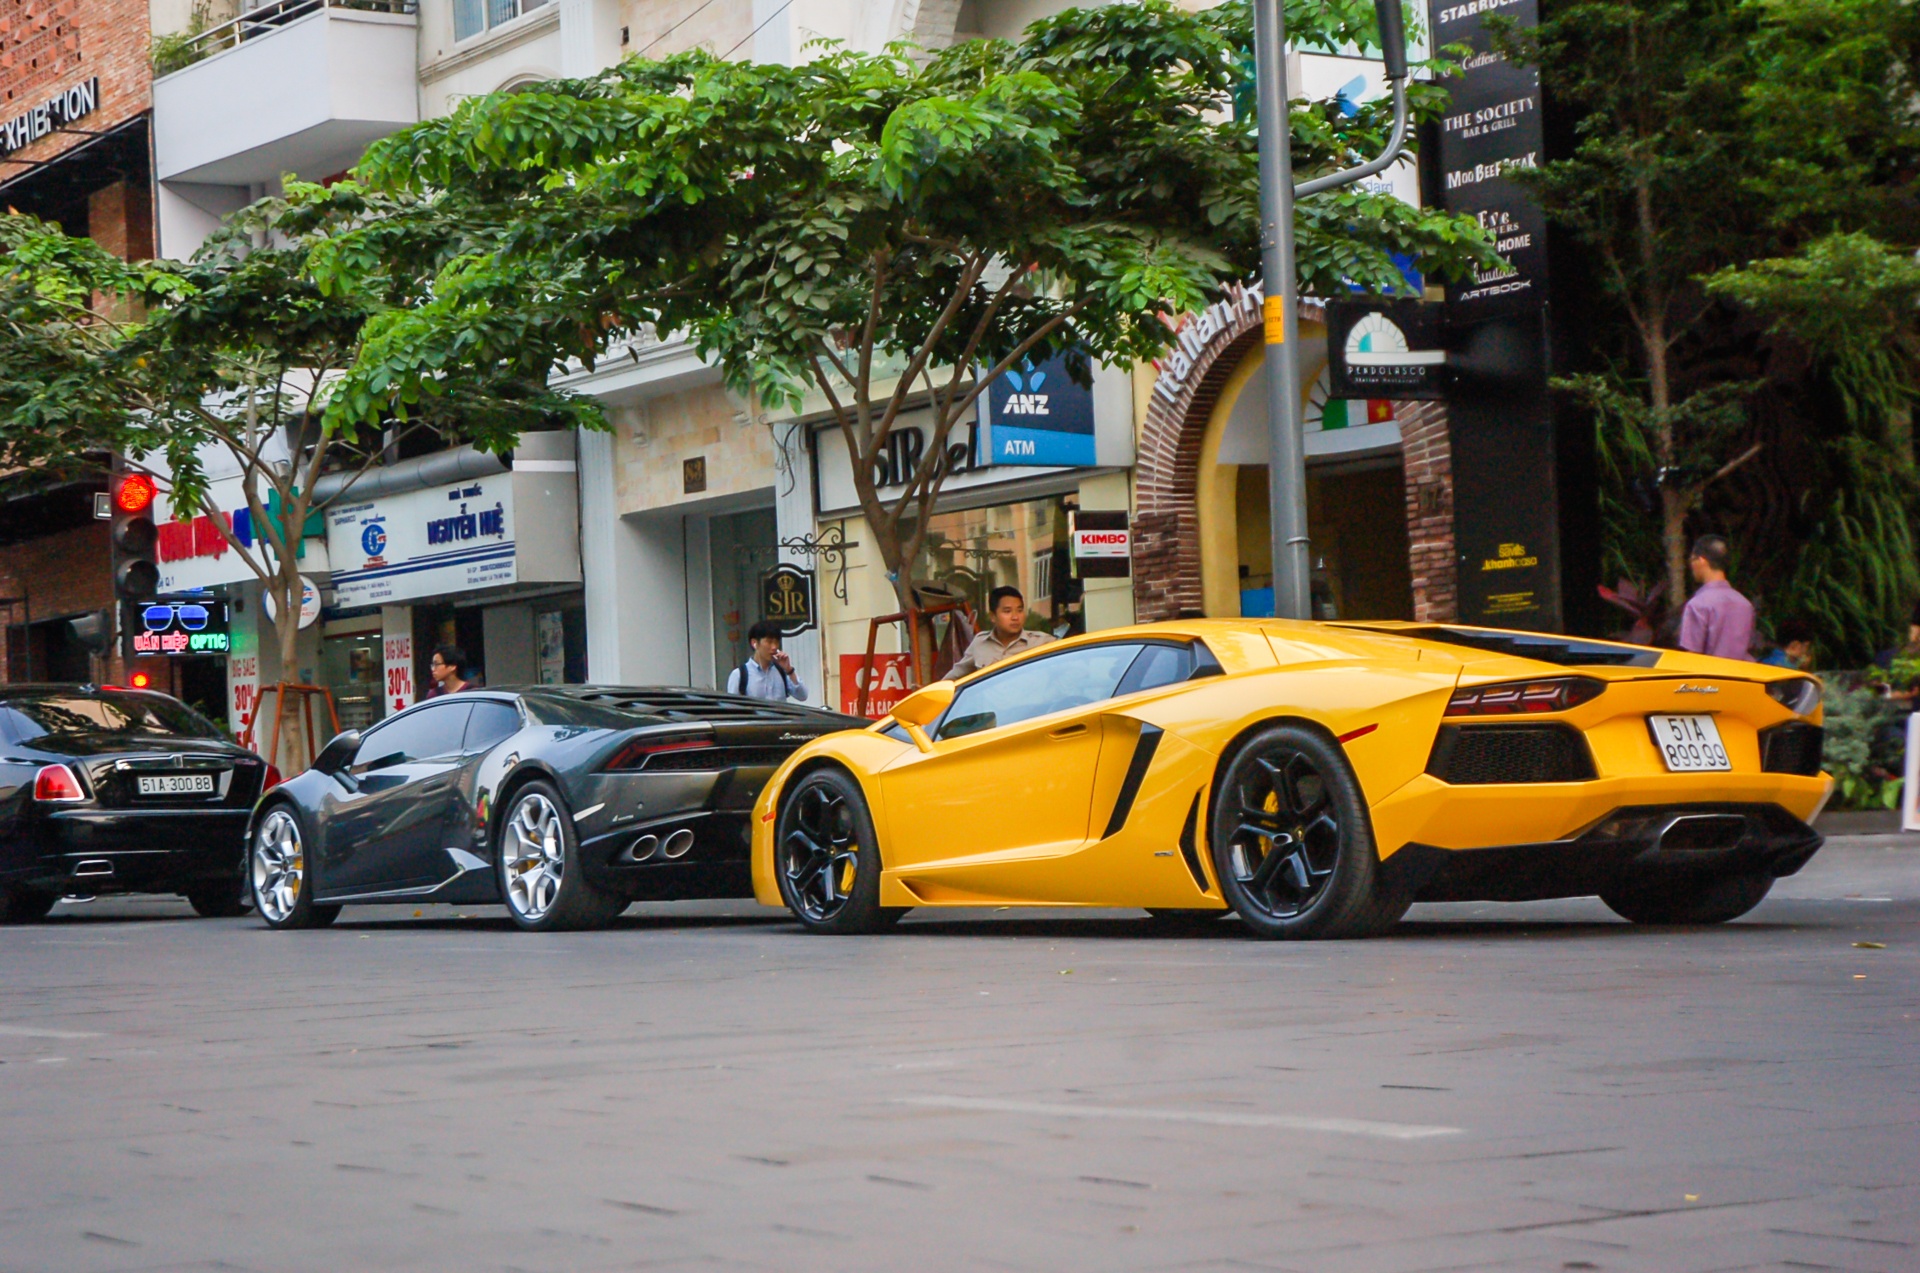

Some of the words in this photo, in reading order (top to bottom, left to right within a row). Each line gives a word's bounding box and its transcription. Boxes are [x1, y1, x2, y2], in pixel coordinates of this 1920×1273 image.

[1440, 0, 1518, 23] STARBU
[1444, 113, 1471, 132] THE
[1476, 97, 1534, 124] SOCIETY
[1463, 127, 1480, 138] BAR
[1491, 117, 1517, 131] GRILL
[1498, 234, 1531, 252] HOME
[1460, 280, 1531, 301] ARTBOOK
[1154, 298, 1235, 404] Italian
[1348, 366, 1426, 376] PENDOLASCO
[1003, 394, 1049, 415] ANZ
[1004, 440, 1035, 456] ATM
[1081, 534, 1127, 544] KIMBO
[770, 590, 806, 615] SIR
[190, 633, 226, 650] OPTIC
[386, 640, 396, 660] BIG
[396, 638, 410, 659] SALE
[232, 659, 242, 678] BIG
[243, 657, 256, 677] SALE
[388, 667, 411, 696] 30%
[235, 684, 256, 711] 30%
[1667, 717, 1706, 741] 51A
[1666, 743, 1727, 767] 899.99
